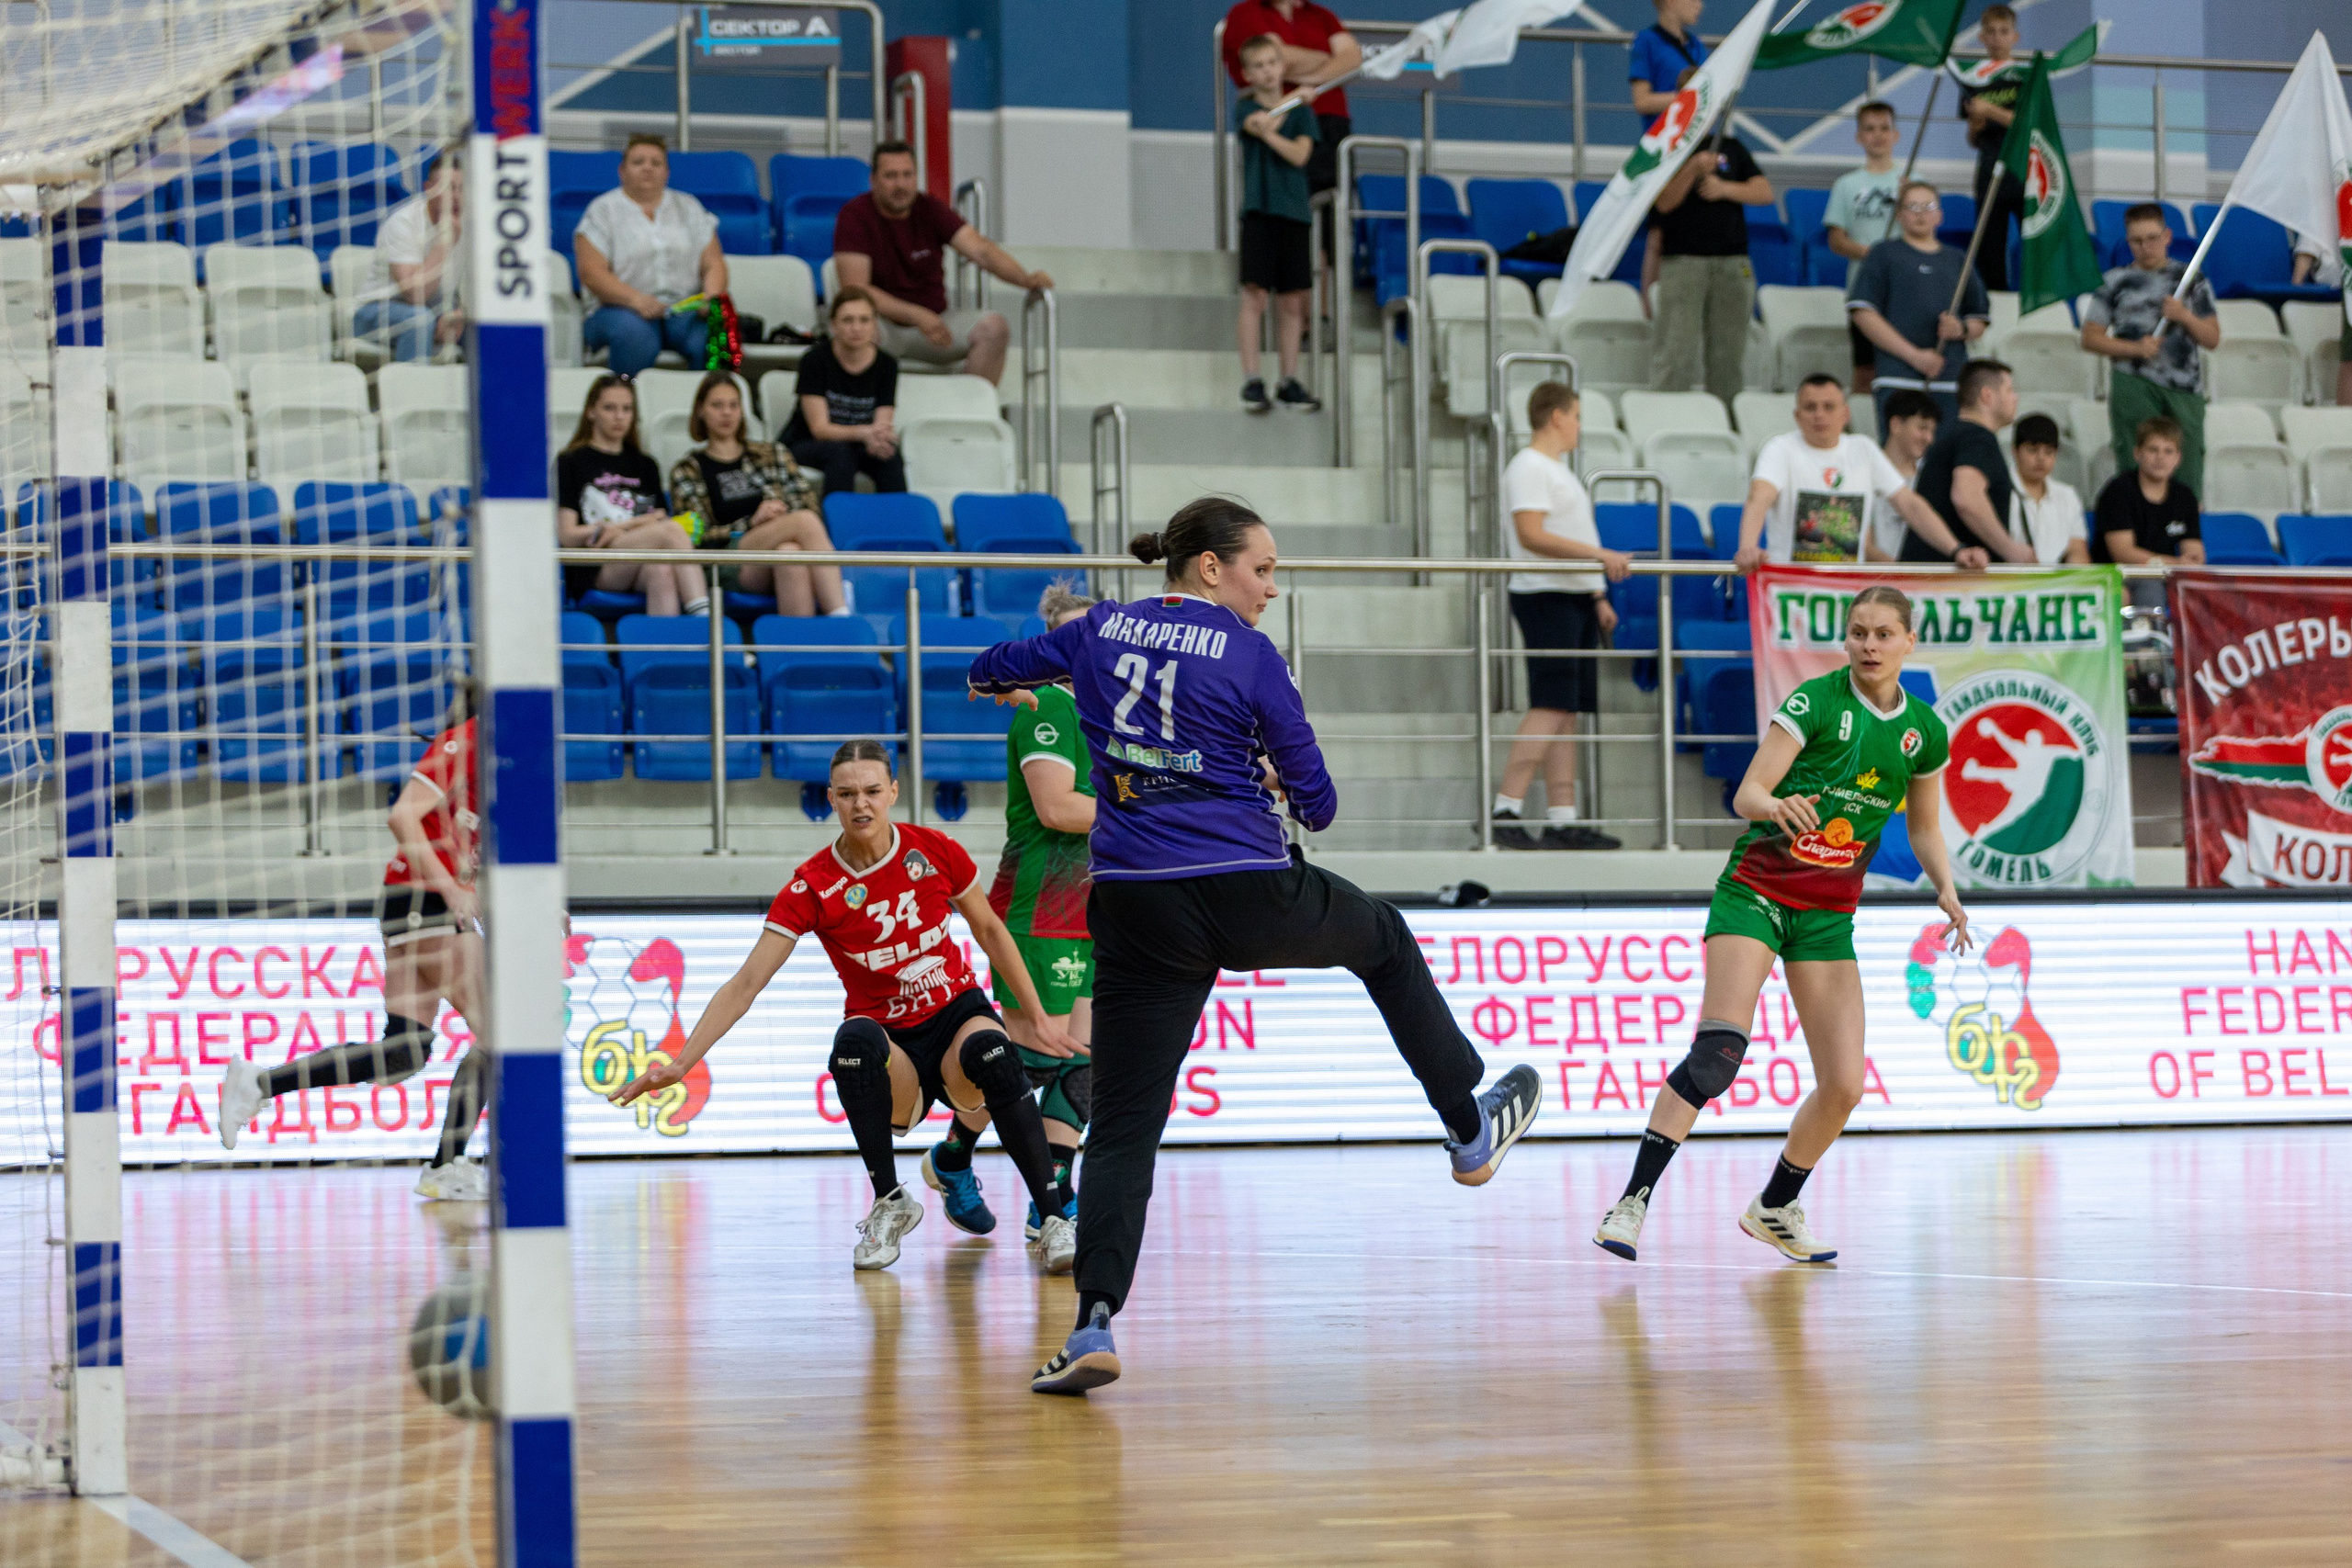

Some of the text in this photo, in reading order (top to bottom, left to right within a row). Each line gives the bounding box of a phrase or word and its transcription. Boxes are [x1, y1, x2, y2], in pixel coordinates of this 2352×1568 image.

[489, 7, 533, 299] SPORT WERK
[1098, 612, 1227, 659] МАКАРЕНКО
[1776, 592, 2098, 643] ГОЛЬЧАНЕ
[1114, 652, 1178, 741] 21
[1943, 680, 2100, 757] ГАНДБОЛЬНЫЙ КЛУБ
[1838, 710, 1853, 741] 9
[1126, 744, 1202, 772] BelFert
[1957, 839, 2051, 883] ГОМЕЛЬ
[820, 875, 848, 899] Kempa
[866, 889, 923, 943] 34
[837, 1057, 862, 1066] SELECT
[982, 1045, 1005, 1061] SELECT
[2150, 1049, 2215, 1099] OF
